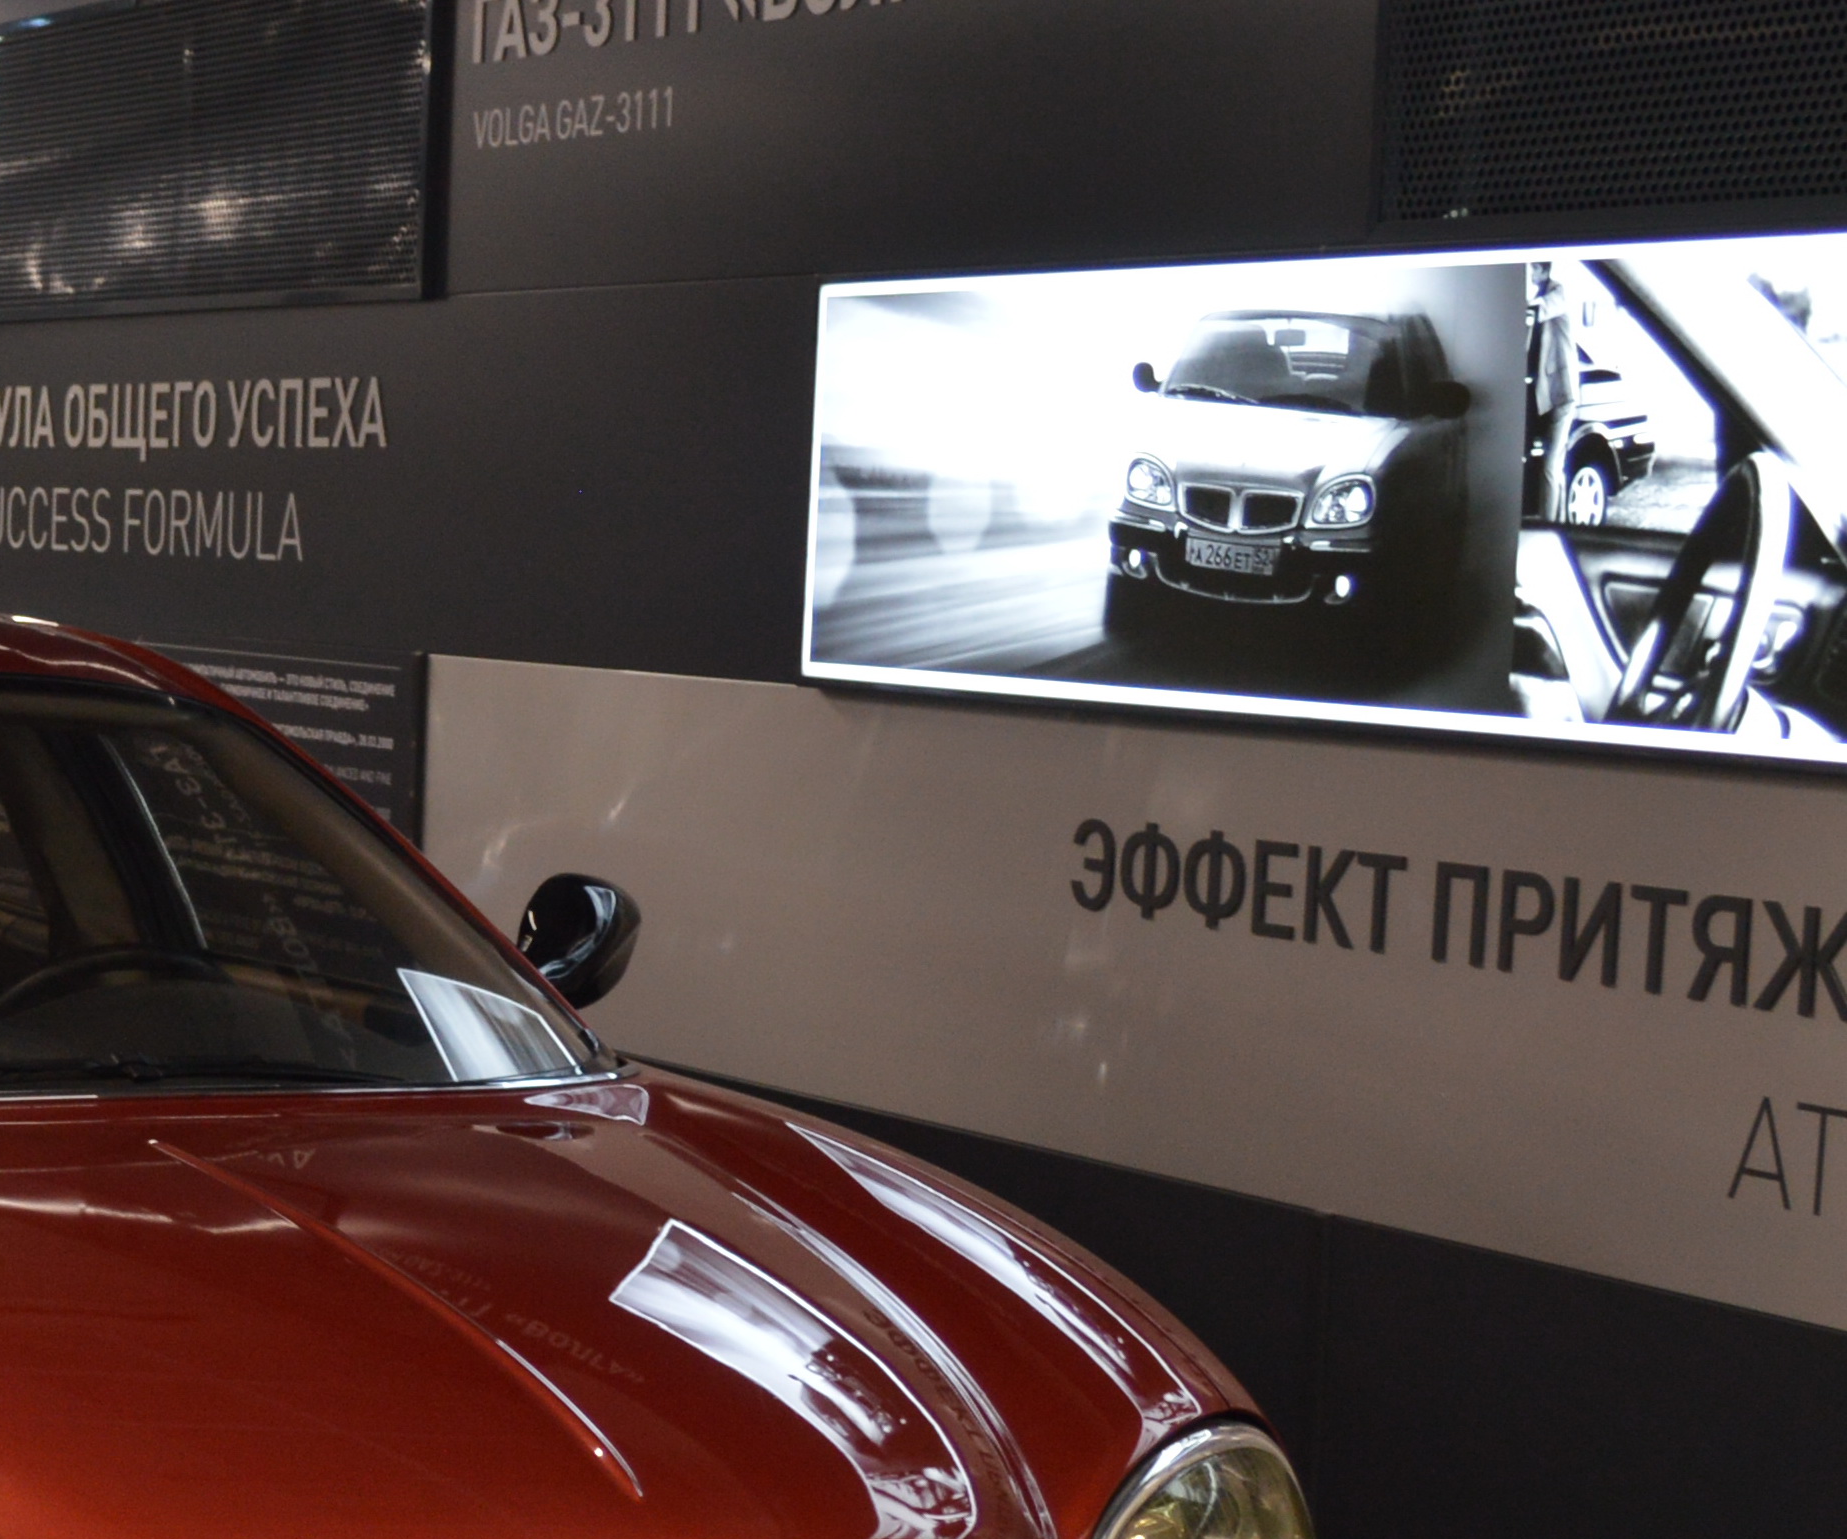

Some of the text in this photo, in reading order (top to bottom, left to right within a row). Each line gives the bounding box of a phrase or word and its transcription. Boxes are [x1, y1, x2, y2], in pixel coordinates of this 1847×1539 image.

[473, 86, 673, 149] VOLGA GAZ-3111
[64, 381, 217, 462] ОБЩЕГО
[227, 376, 387, 449] УСПЕХА
[123, 489, 303, 561] FORMULA
[1070, 817, 1847, 1024] ЭФФЕКТ ПРИТЯЖ
